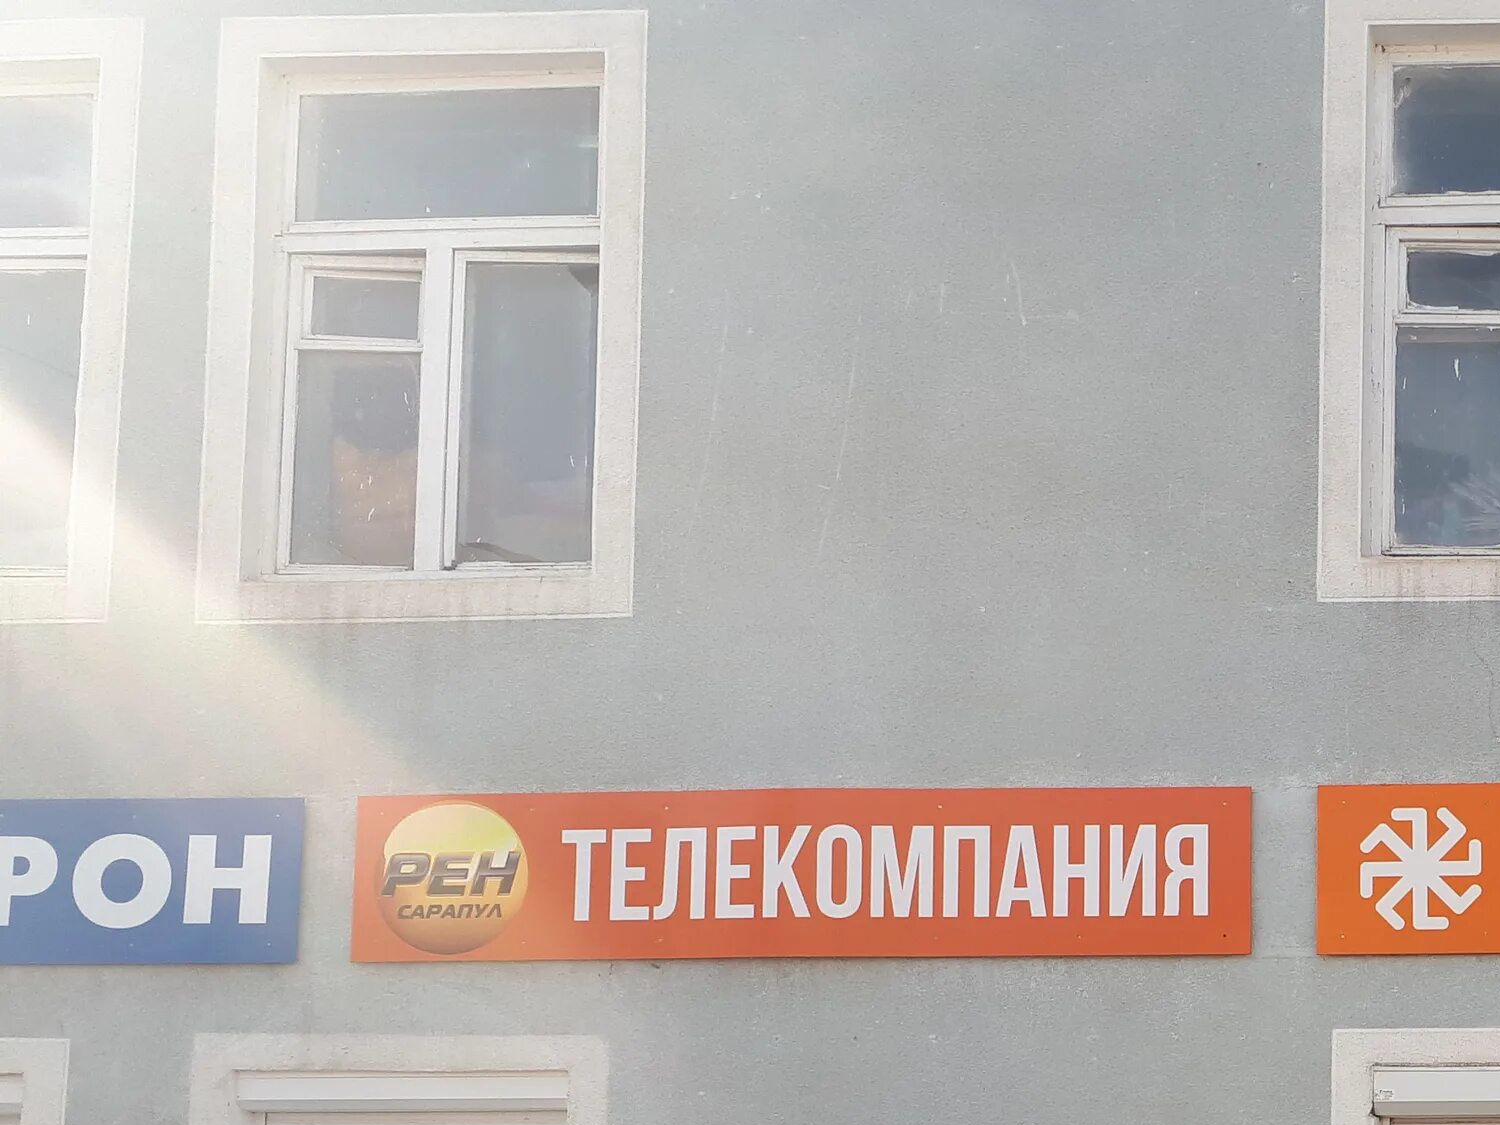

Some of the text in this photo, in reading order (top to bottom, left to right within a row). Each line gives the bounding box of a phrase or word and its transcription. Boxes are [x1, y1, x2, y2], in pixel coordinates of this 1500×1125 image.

[0, 834, 272, 929] РОН
[380, 850, 521, 897] РЕН
[562, 823, 1209, 921] ТЕЛЕКОМПАНИЯ
[397, 902, 502, 920] САРАПУЛ
